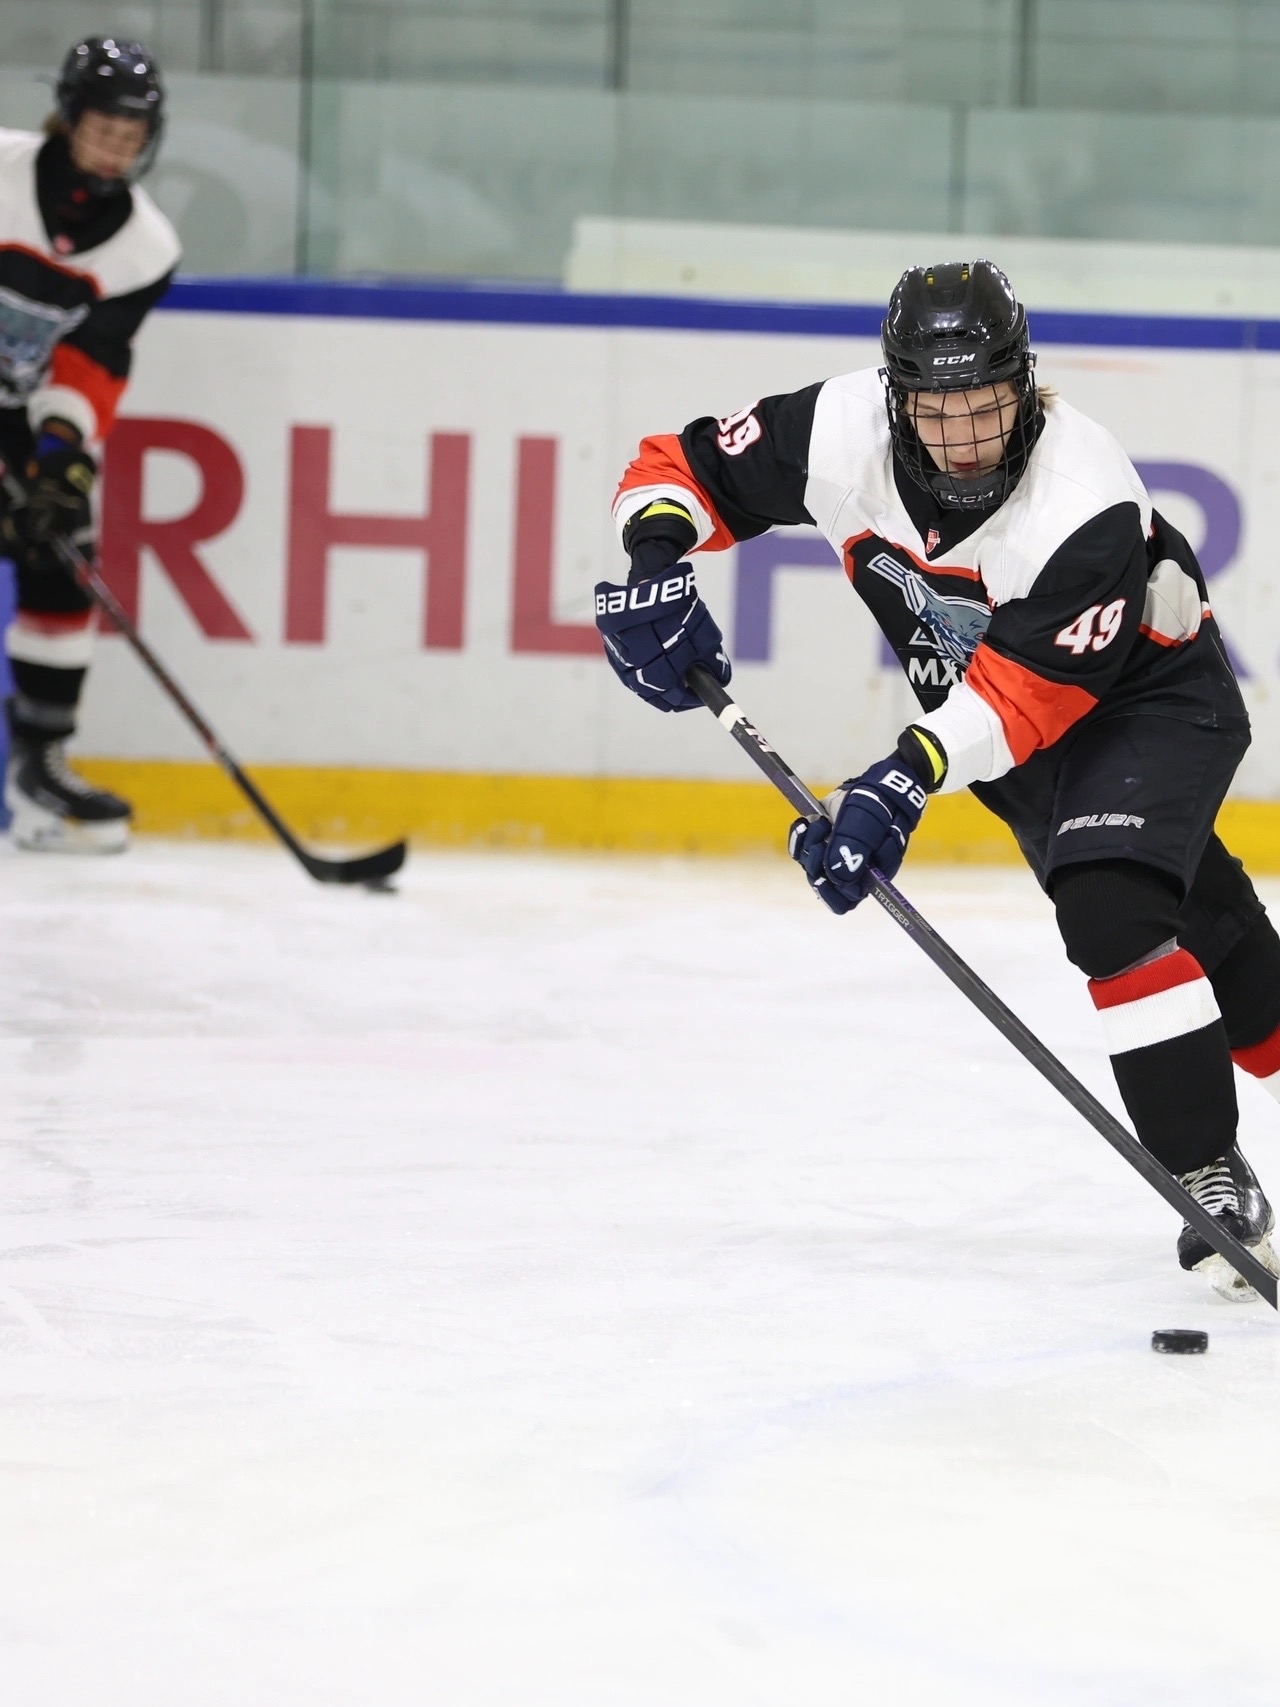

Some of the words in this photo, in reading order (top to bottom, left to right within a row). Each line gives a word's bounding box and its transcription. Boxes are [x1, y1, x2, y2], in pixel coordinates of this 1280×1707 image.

[932, 353, 976, 366] CCM
[947, 490, 994, 503] CCM
[1053, 597, 1127, 656] 49
[874, 887, 910, 928] TRIGGER
